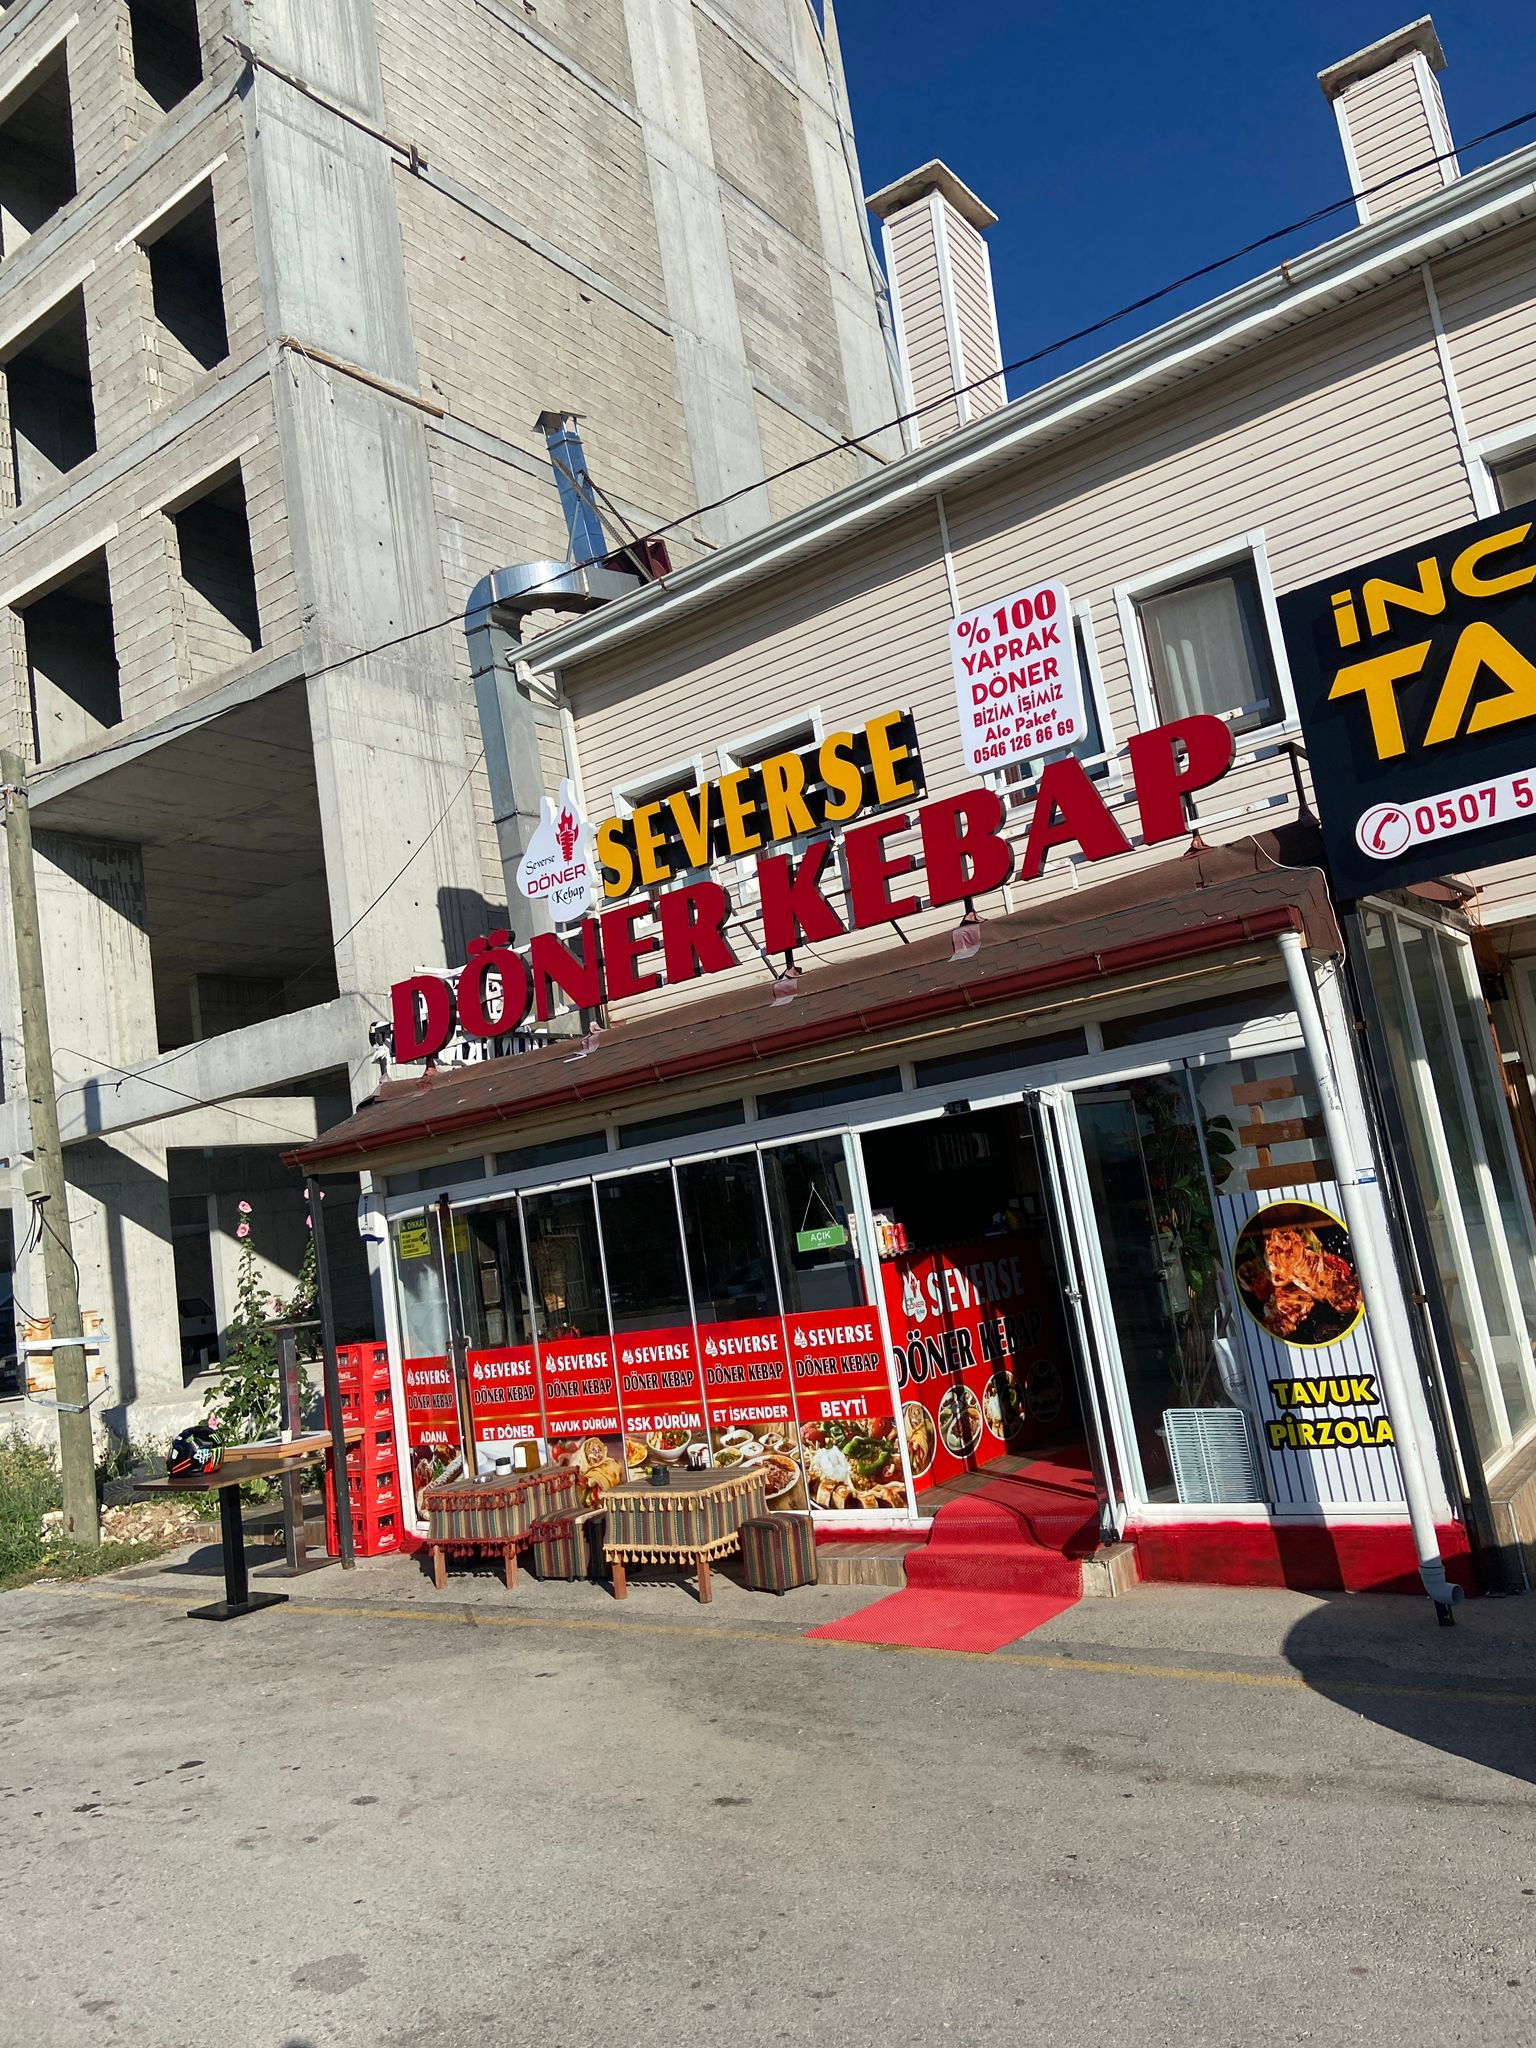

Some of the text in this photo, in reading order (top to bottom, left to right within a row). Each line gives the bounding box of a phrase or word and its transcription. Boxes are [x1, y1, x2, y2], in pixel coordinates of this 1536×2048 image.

[961, 623, 1061, 676] YAPRAK
[972, 656, 1059, 705] DÖNER
[973, 682, 1063, 728] BİZİM İŞİMİZ
[985, 708, 1058, 743] Alo Paket
[973, 718, 1075, 764] 0546 126 86 69
[597, 710, 916, 898] SEVERSE
[1415, 777, 1533, 836] 0507 5
[525, 854, 556, 876] Severse
[391, 714, 1236, 1064] DÖNER KEBAP
[527, 863, 587, 895] DÖNER
[551, 885, 585, 905] Kebap
[810, 1230, 831, 1243] AÇIK
[926, 1256, 1025, 1317] SEVERSE
[719, 1333, 778, 1356] SEVERSE
[809, 1323, 873, 1347] SEVERSE
[557, 1351, 608, 1372] SEVERSE
[634, 1343, 690, 1364] SEVERSE
[484, 1360, 532, 1379] SEVERSE
[707, 1361, 783, 1385] DÖNER KEBAP
[796, 1353, 879, 1378] DÖNER KEBAP
[415, 1369, 451, 1386] SEVERSE
[546, 1377, 612, 1399] DÖNER KEBAP
[623, 1370, 694, 1391] DÖNER KEBAP
[408, 1393, 453, 1410] DÖNER KEBAP
[475, 1384, 535, 1405] DÖNER KEBAP
[1272, 1377, 1376, 1406] TAVUK
[713, 1404, 789, 1423] ET İSKENDER
[820, 1394, 868, 1418] BEYTİ
[482, 1423, 535, 1441] ET DÖNER
[550, 1416, 617, 1433] TAVUK DÜRÜM
[627, 1412, 701, 1431] SSK DÜRÜM
[1268, 1415, 1395, 1447] PİRZOLA
[420, 1430, 448, 1444] ADANA
